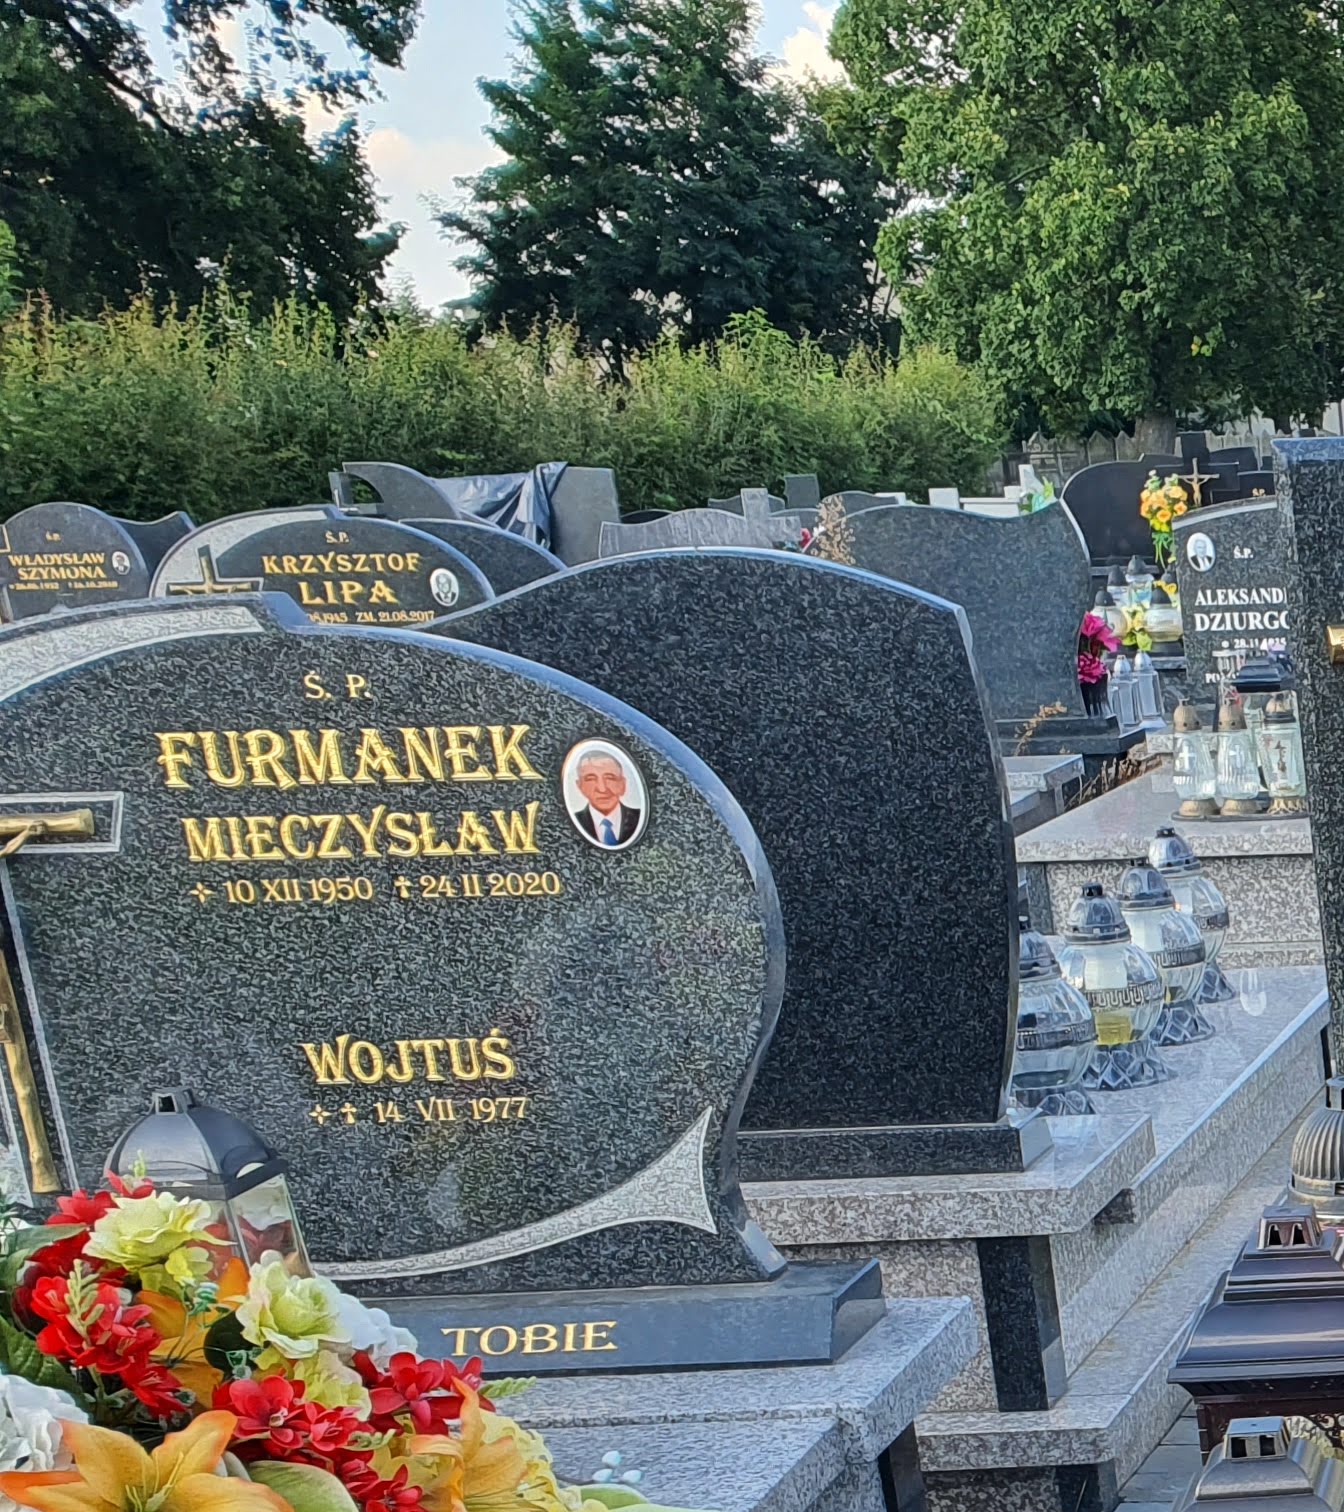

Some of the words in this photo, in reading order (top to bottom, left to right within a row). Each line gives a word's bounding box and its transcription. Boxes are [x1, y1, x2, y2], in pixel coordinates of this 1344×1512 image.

[325, 531, 350, 543] Ś.P.
[262, 551, 421, 574] KRZYSZTOF
[1233, 546, 1254, 559] Ś.P.
[17, 566, 108, 580] SZYMONA
[298, 579, 399, 605] LIPA
[345, 673, 372, 698] P.
[155, 724, 545, 790] FURMANEK
[181, 801, 543, 862] MIECZYSŁAW
[222, 878, 255, 904] 10
[261, 877, 299, 902] XII
[306, 875, 374, 901] 1950
[419, 874, 458, 898] 24
[460, 872, 482, 898] II
[488, 870, 561, 896] 2020
[302, 1028, 517, 1086] WOJTUŚ
[373, 1100, 406, 1124] 14
[413, 1099, 457, 1123] VII
[467, 1095, 529, 1123] 1977
[441, 1320, 620, 1358] TOBIE
